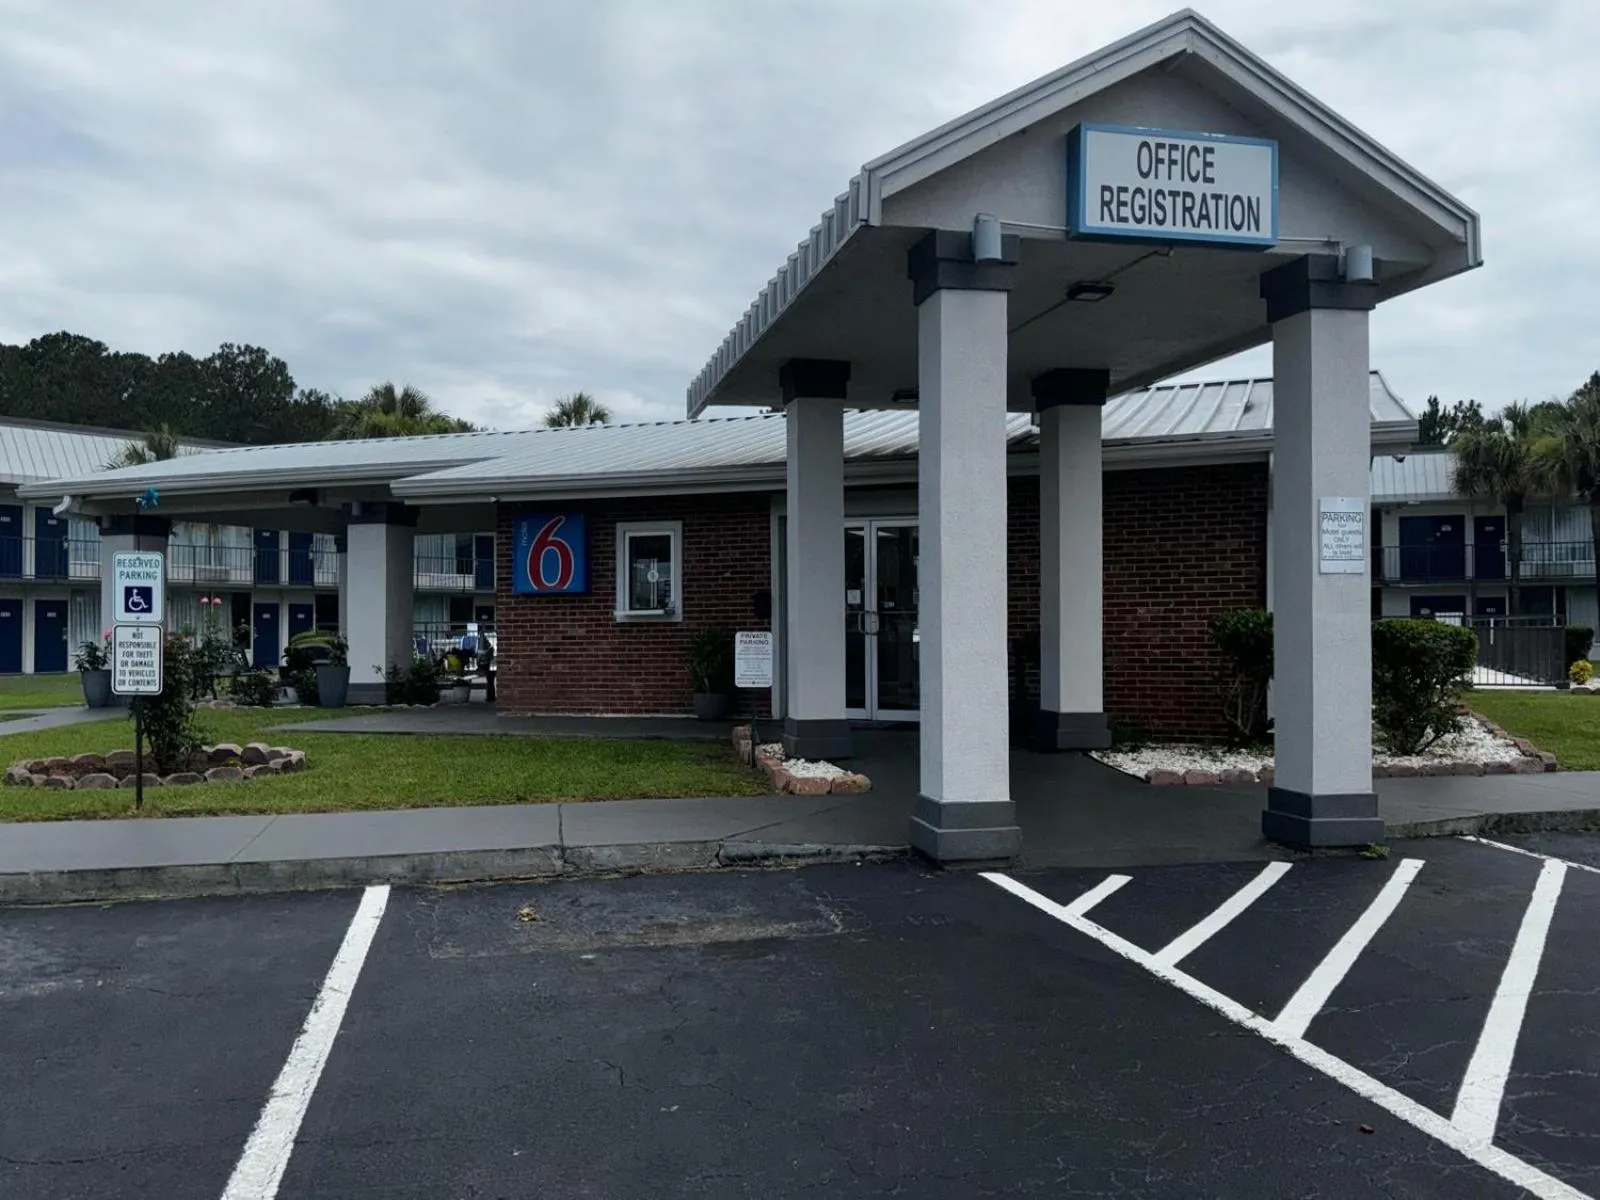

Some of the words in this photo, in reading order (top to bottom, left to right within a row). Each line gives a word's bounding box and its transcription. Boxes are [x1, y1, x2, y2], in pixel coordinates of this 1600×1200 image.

[1137, 140, 1215, 184] OFFICE
[1100, 184, 1260, 232] REGISTRATION
[1322, 513, 1362, 523] PARKING
[526, 515, 575, 592] 6
[117, 558, 160, 569] RESERVED
[119, 570, 158, 581] PARKING
[131, 631, 143, 639] NOT
[118, 641, 157, 649] RESPONSIBLE
[122, 650, 134, 658] FOR
[136, 650, 153, 658] THEFT
[131, 660, 154, 668] DAMAGE
[119, 669, 127, 677] TO
[128, 669, 156, 677] VEHICLES
[117, 678, 126, 686] OR
[128, 678, 157, 687] CONTENTS
